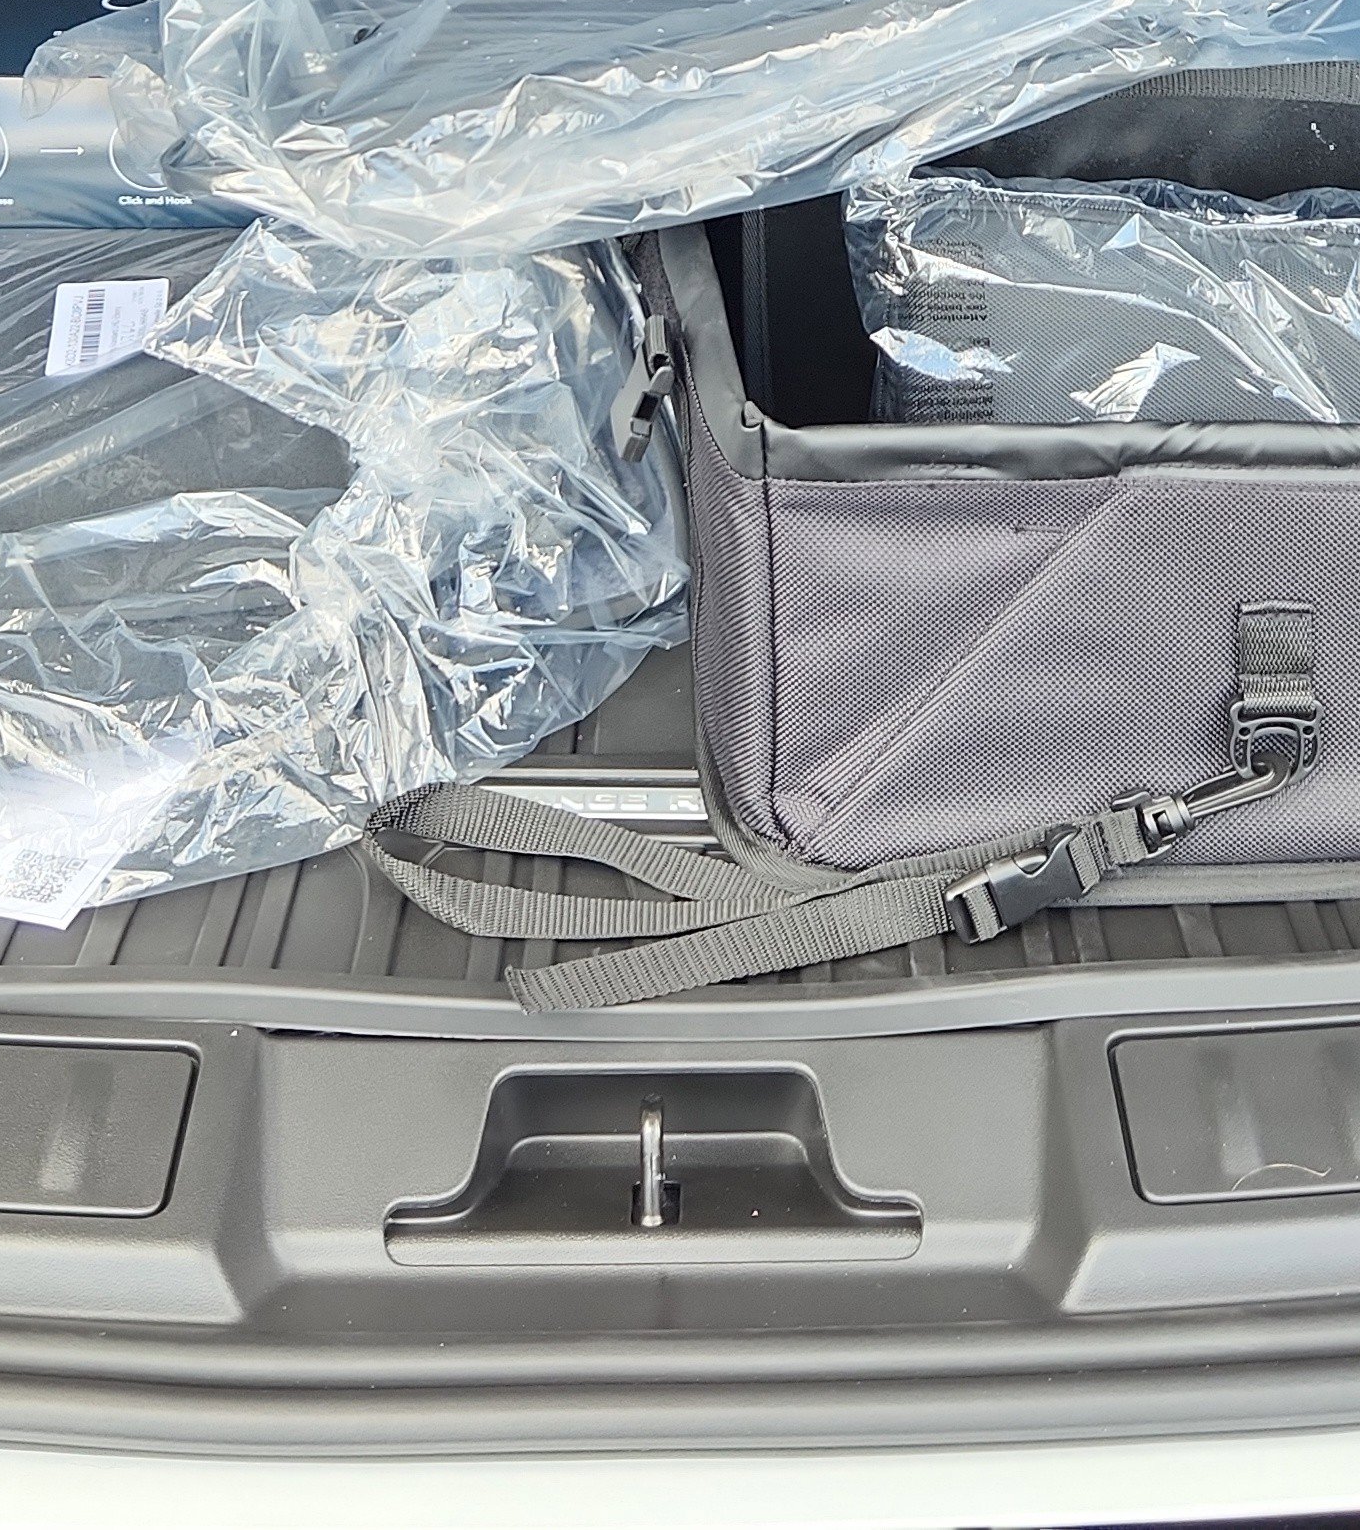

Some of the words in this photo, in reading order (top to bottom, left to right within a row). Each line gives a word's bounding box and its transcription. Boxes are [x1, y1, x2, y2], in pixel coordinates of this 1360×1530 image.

[119, 195, 143, 205] Click
[144, 195, 164, 205] and
[165, 195, 193, 205] Hook
